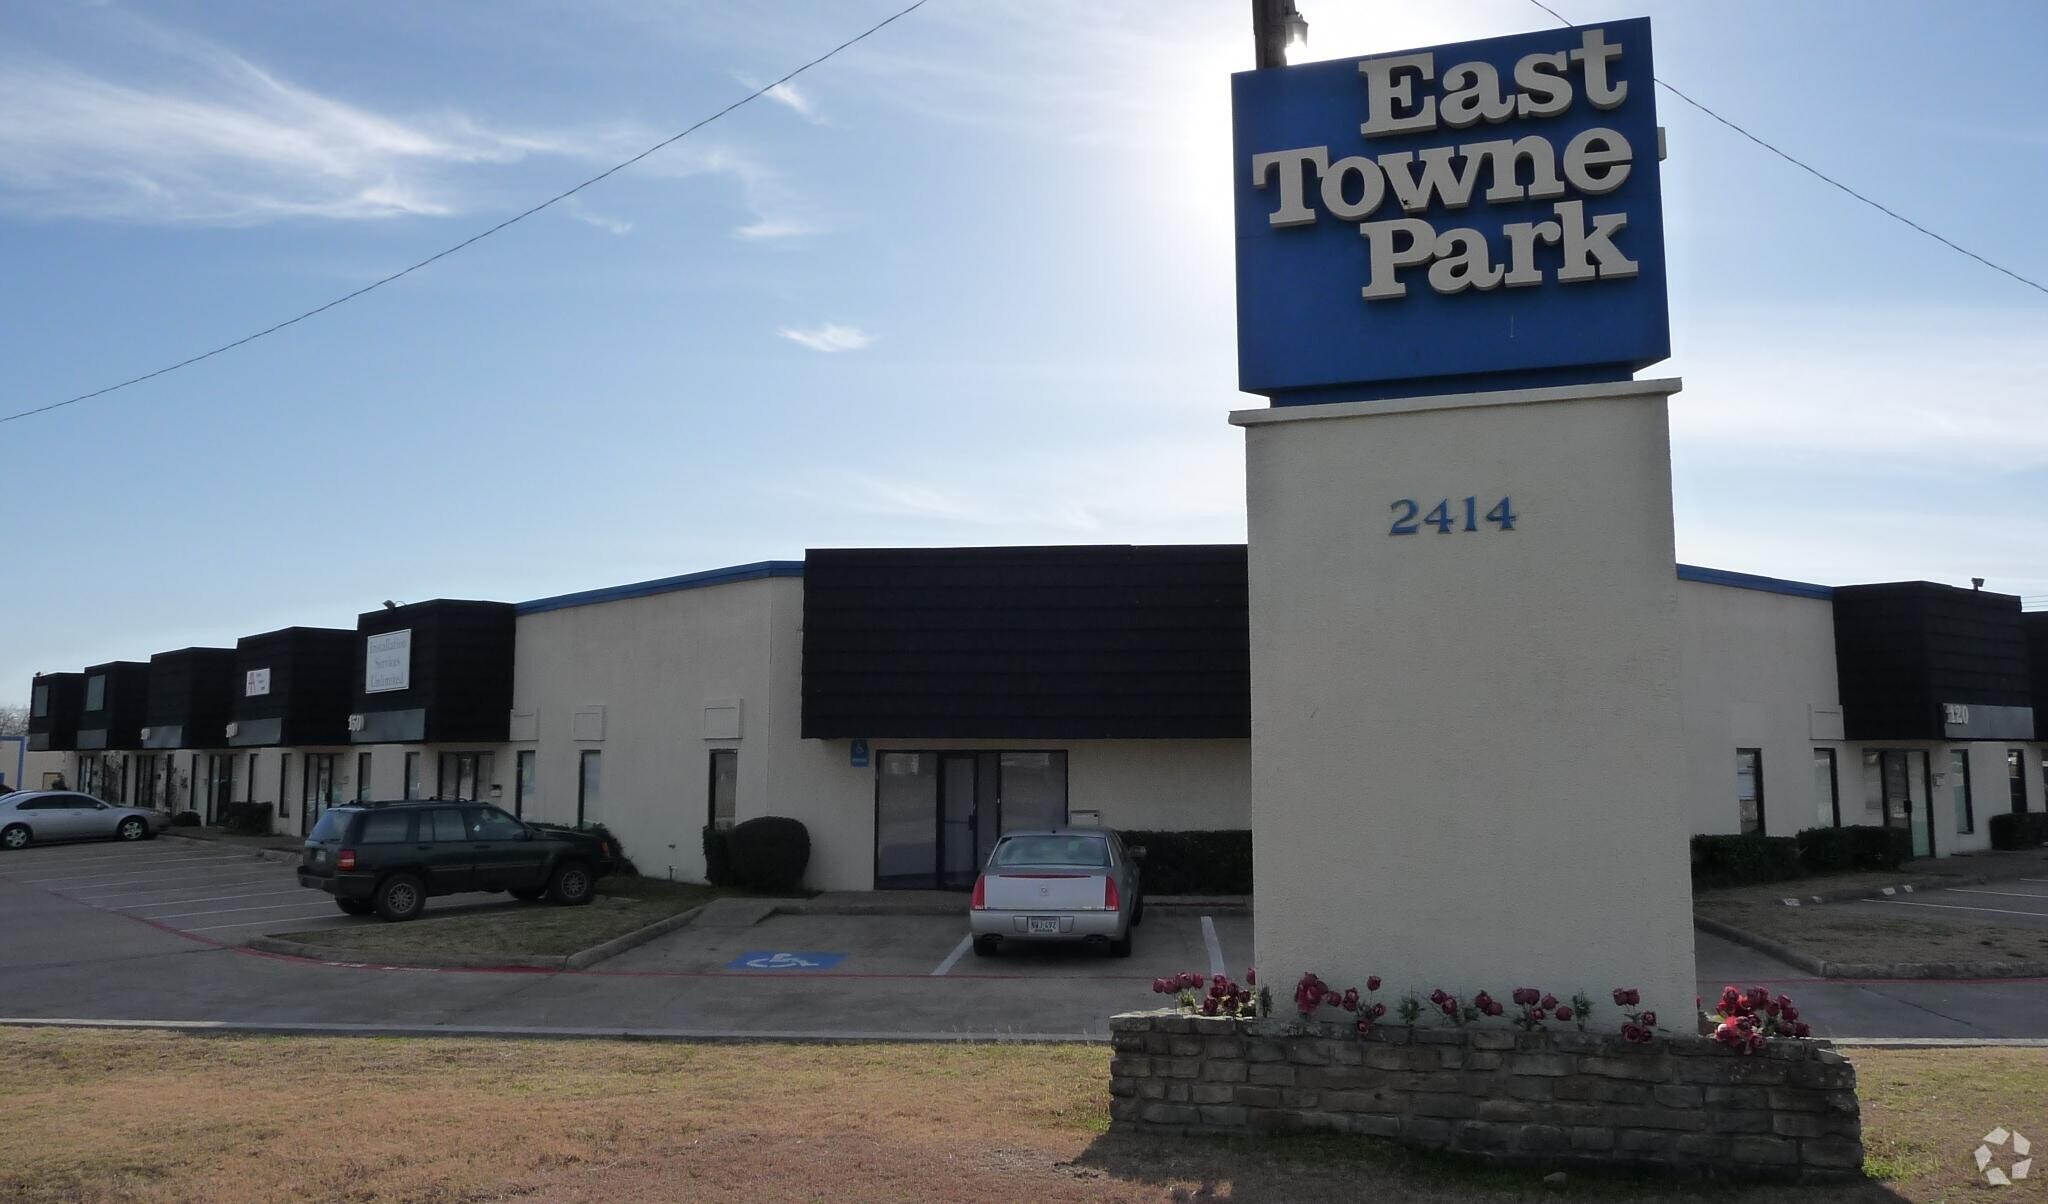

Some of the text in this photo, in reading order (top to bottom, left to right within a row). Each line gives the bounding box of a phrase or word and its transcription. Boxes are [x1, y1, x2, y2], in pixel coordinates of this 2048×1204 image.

[1358, 28, 1628, 138] East
[1252, 127, 1633, 228] Towne
[1360, 200, 1639, 301] Park
[1388, 495, 1518, 535] 2414
